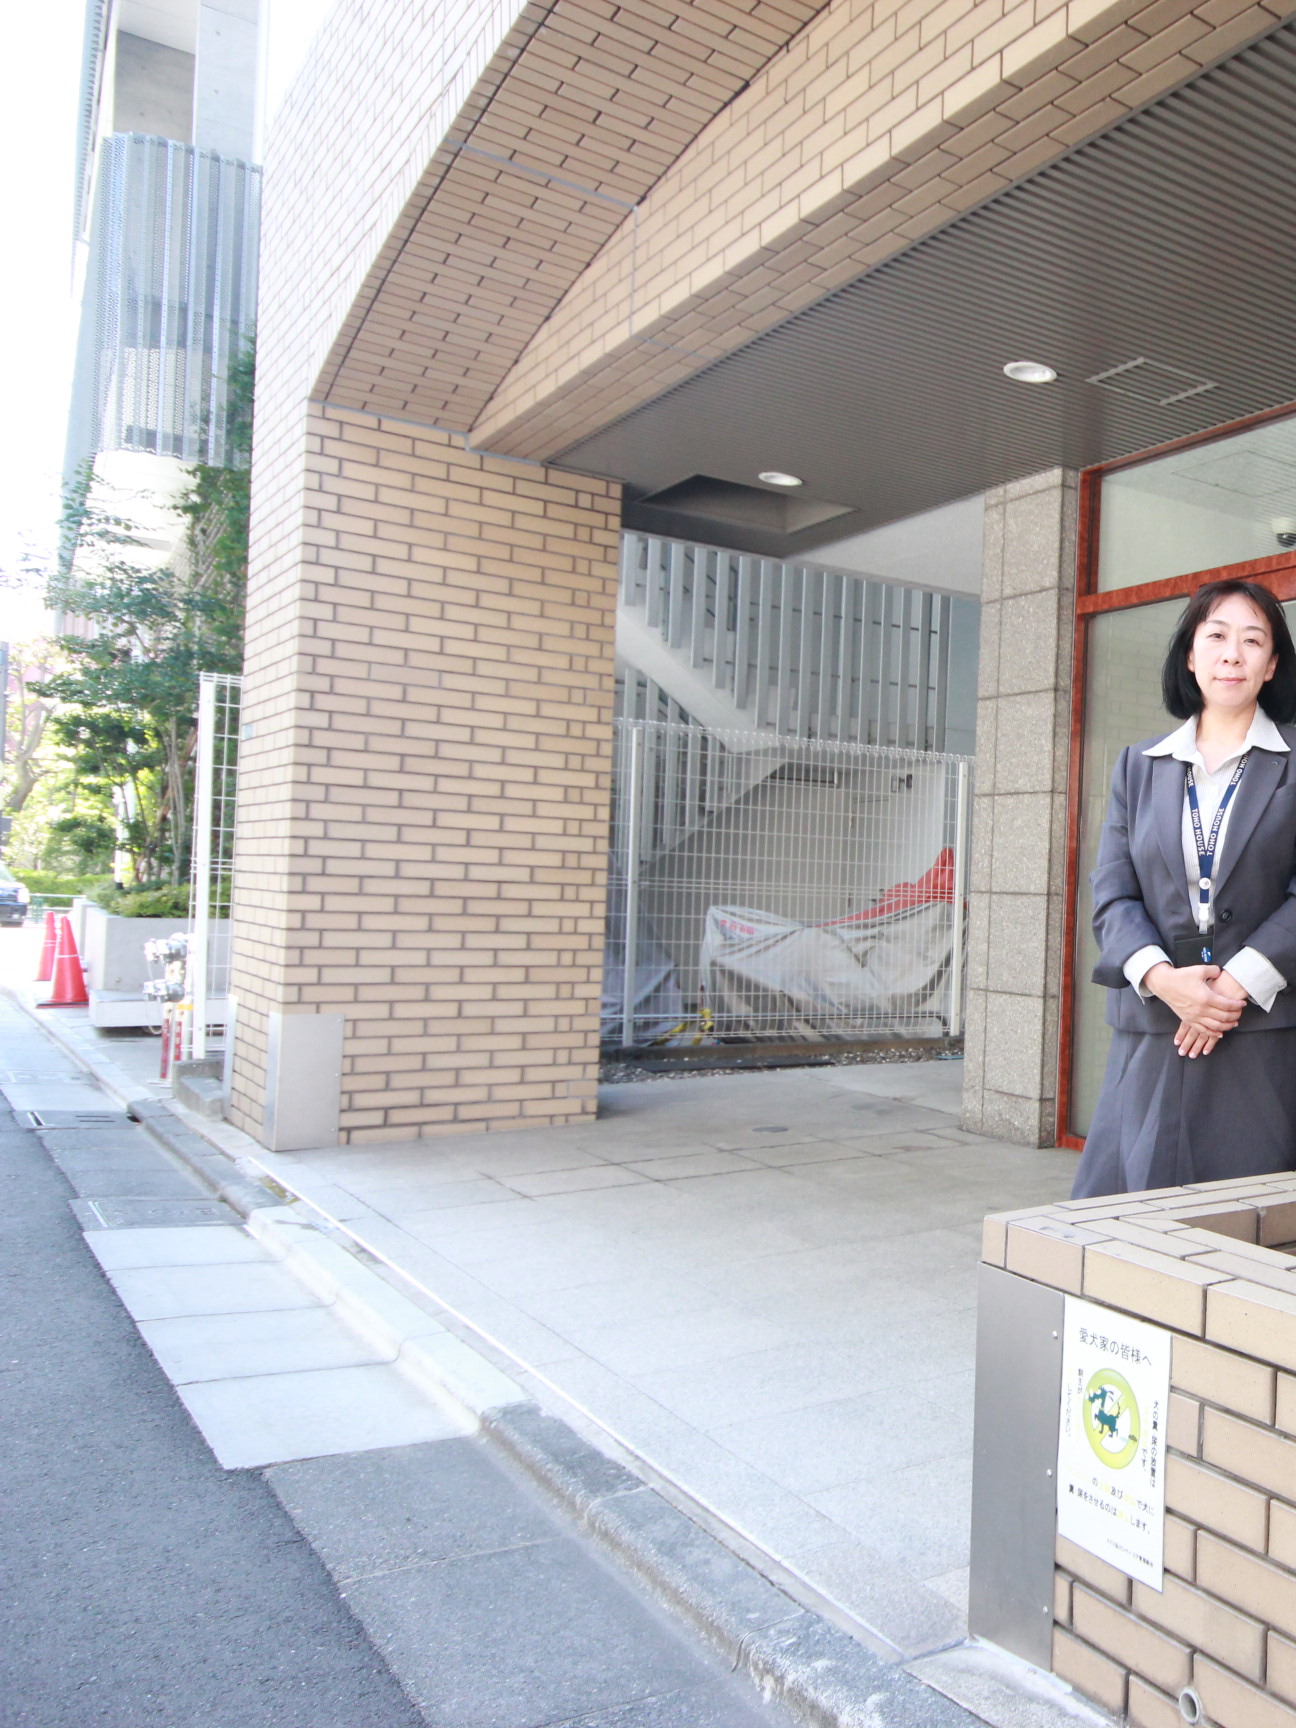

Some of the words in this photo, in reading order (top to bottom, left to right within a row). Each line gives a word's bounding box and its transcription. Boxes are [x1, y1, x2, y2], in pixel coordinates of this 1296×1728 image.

[1230, 768, 1243, 786] TOHO
[1192, 808, 1201, 828] TOHO
[1195, 829, 1206, 856] HOUSE
[1207, 833, 1217, 856] TOHO
[1212, 808, 1225, 835] HOUSE
[1079, 1327, 1152, 1366] 愛犬家の皆様へ
